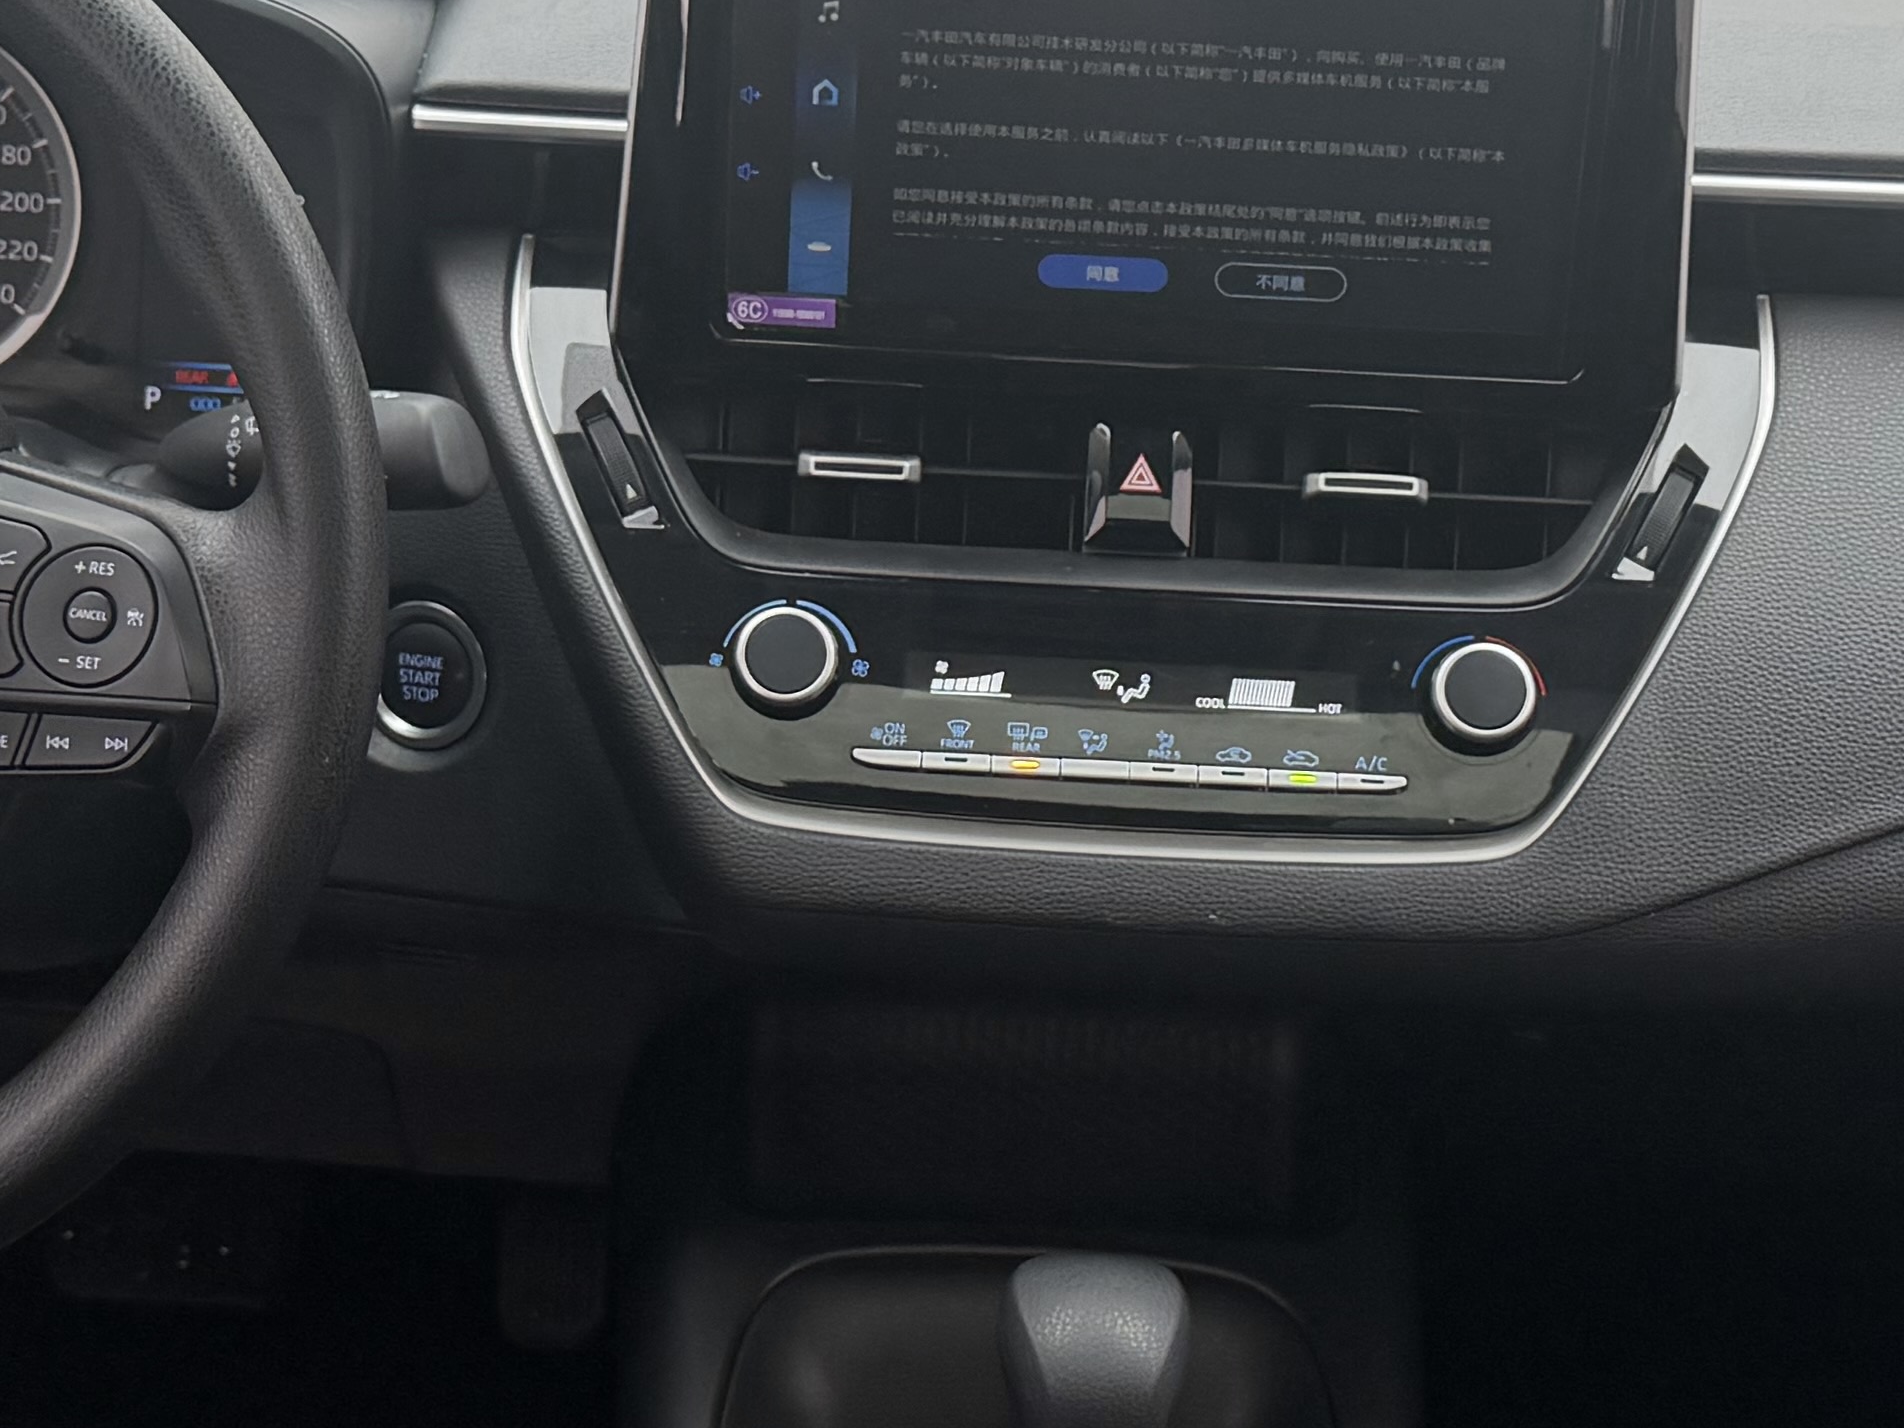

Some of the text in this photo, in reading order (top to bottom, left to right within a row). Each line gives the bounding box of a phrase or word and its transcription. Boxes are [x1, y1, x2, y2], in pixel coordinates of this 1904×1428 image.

[0, 192, 44, 213] 200
[1086, 265, 1120, 283] 同意
[1256, 273, 1306, 293] 不同意
[737, 300, 762, 319] 6C
[144, 385, 161, 410] P
[68, 606, 108, 622] CANCEL
[76, 655, 102, 670] SET
[399, 652, 444, 670] ENGINE
[399, 668, 441, 686] START
[402, 684, 439, 703] STOP
[1195, 697, 1226, 709] COOL
[1318, 703, 1342, 714] HOT
[884, 722, 906, 734] ON
[882, 734, 908, 747] OFF
[940, 738, 975, 750] FRONT
[1011, 741, 1041, 753] REAR
[1147, 748, 1181, 761] PM2.5
[1355, 756, 1388, 771] A/C
